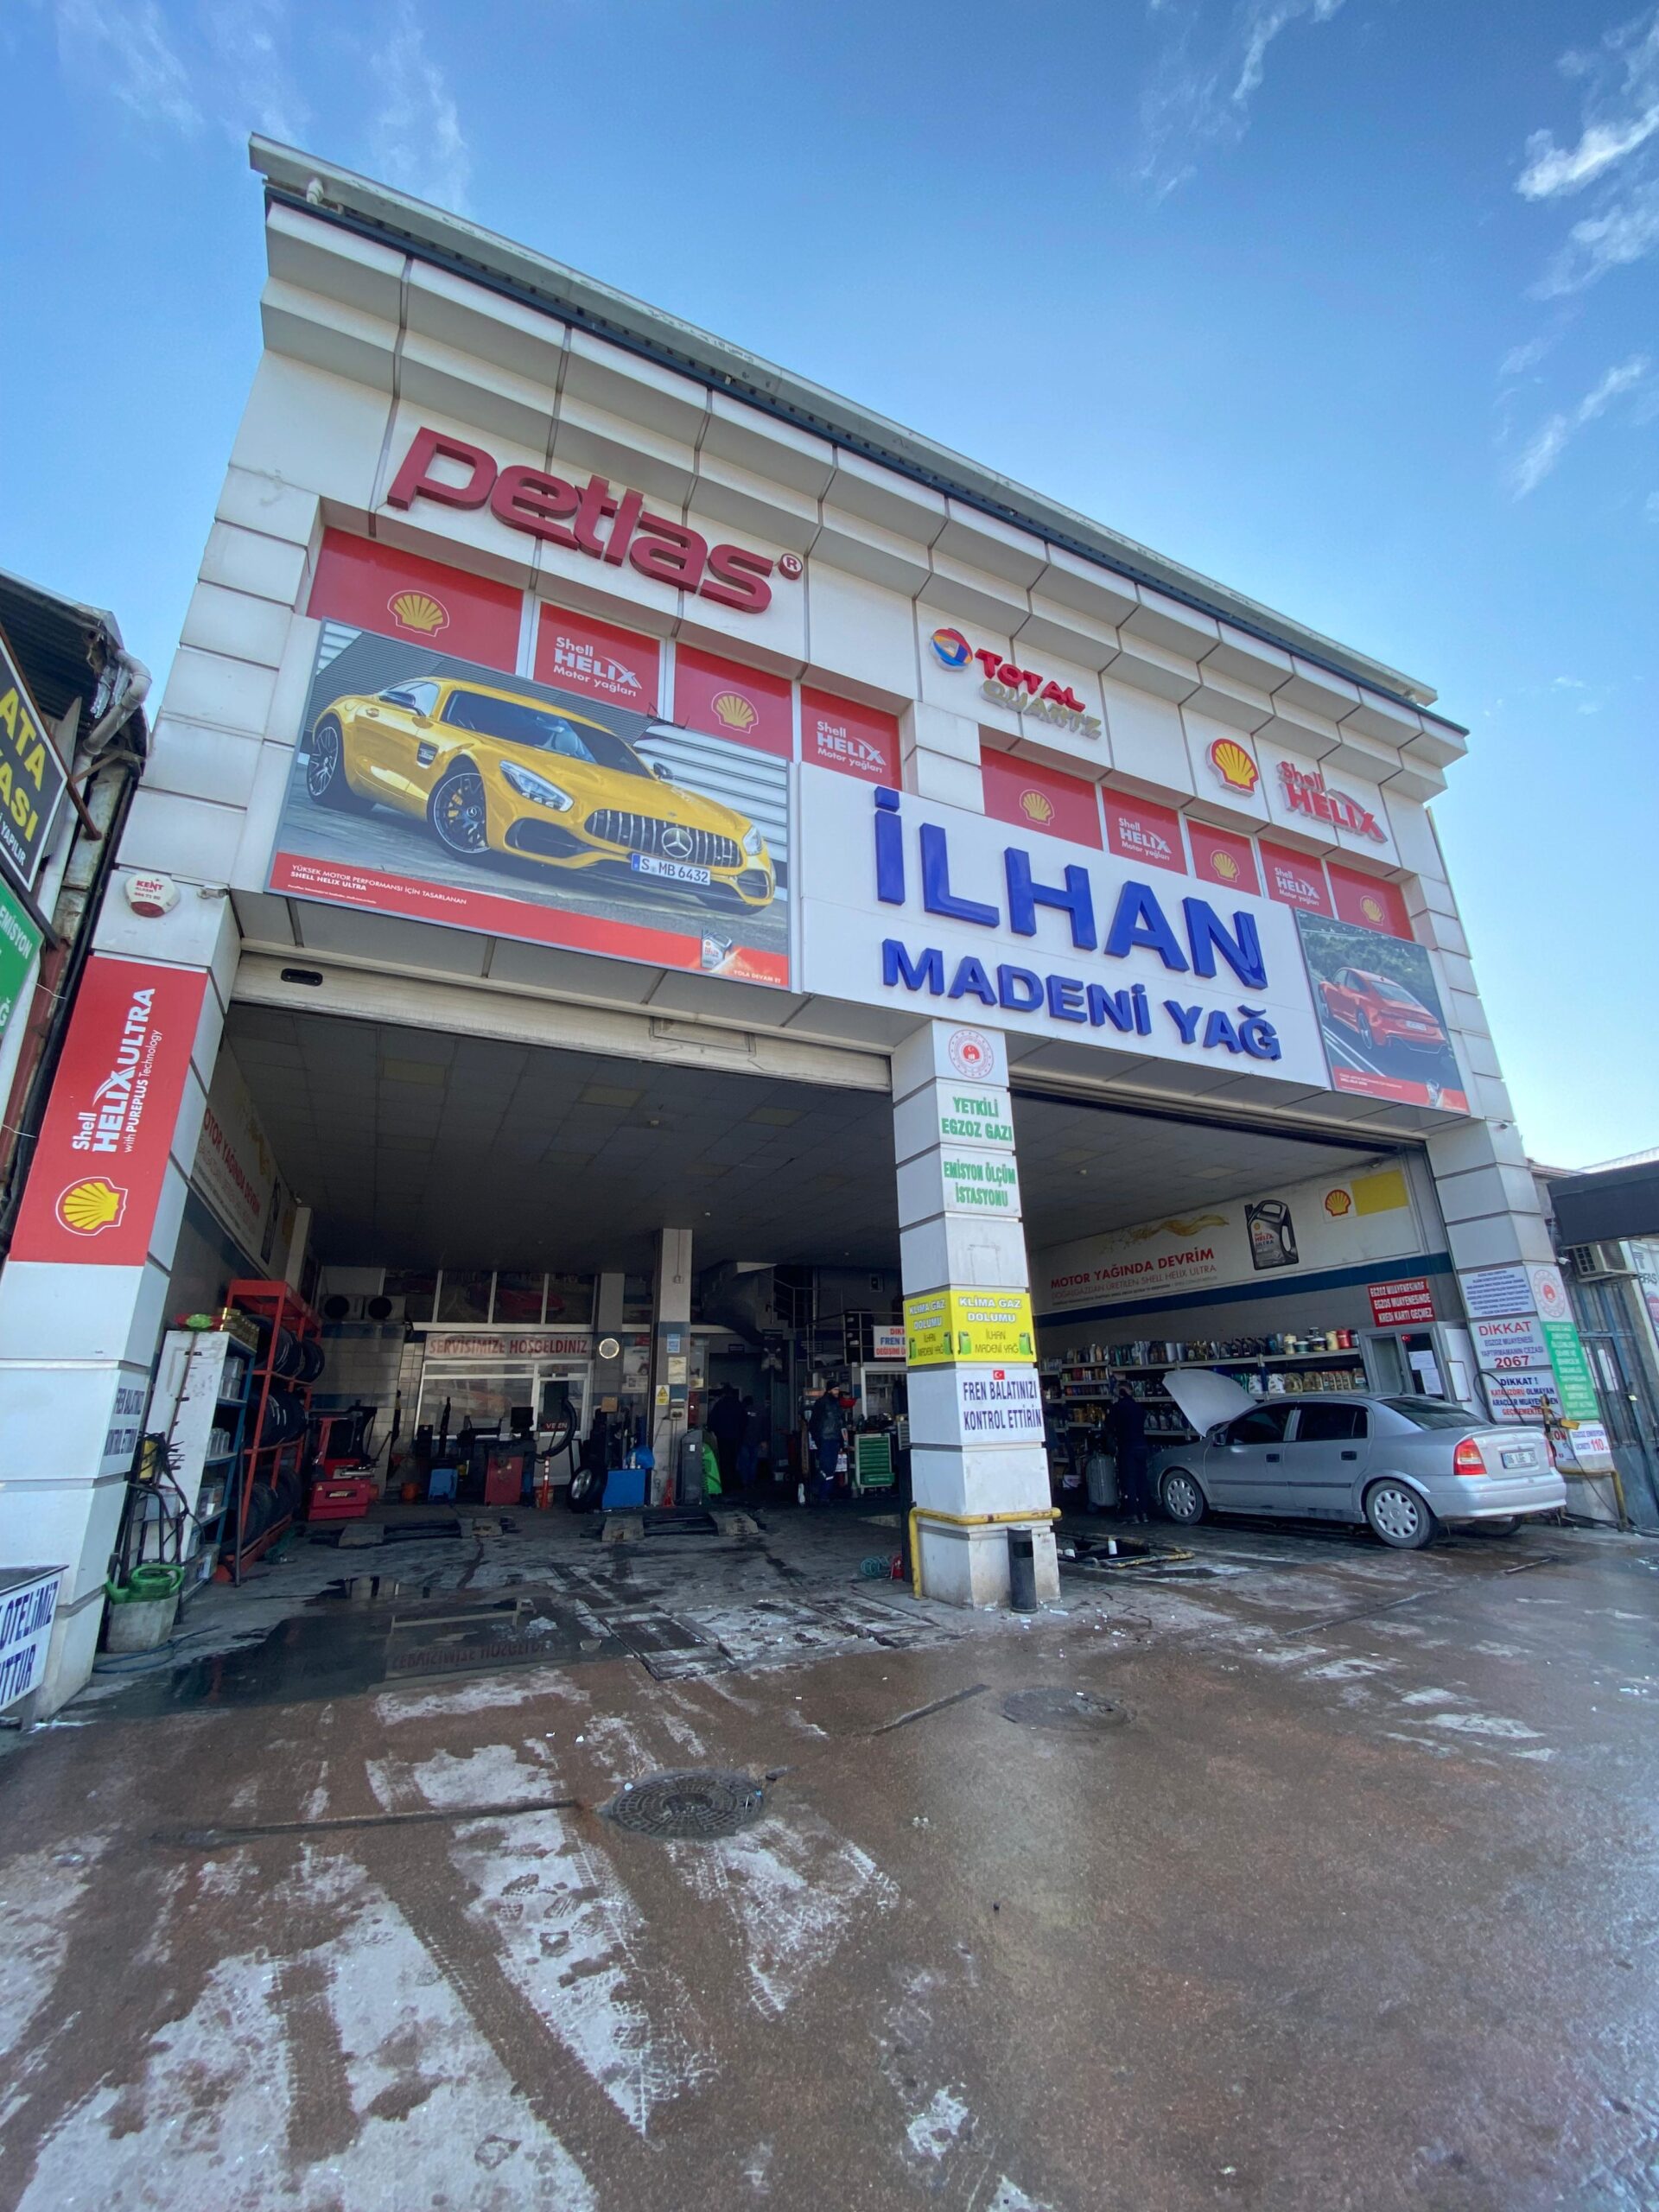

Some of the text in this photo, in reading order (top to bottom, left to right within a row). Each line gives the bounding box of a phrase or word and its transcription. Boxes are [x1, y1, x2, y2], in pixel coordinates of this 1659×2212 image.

[388, 427, 773, 613] petlas
[556, 637, 594, 657] Shell
[553, 665, 637, 697] Motor yağları
[555, 648, 642, 690] HELIX
[975, 648, 1085, 713] TOTAL
[979, 680, 1102, 740] QUARTZ
[817, 721, 847, 738] Shell
[817, 731, 887, 766] HELIX
[817, 747, 847, 762] Motor
[1276, 761, 1325, 792] Shell
[1118, 817, 1141, 831] Shell
[1279, 781, 1389, 843] HELIX
[1, 821, 26, 867] YAPILIR
[1119, 827, 1173, 854] HELIX
[290, 871, 367, 892] SHELL HELIX ULTRA
[291, 864, 467, 905] YÜKSEK MOTOR PERFORMANSI İÇİN TASARLANAN
[658, 861, 676, 875] MB
[678, 866, 709, 884] 6432
[1274, 868, 1294, 880] Shell
[137, 880, 164, 892] KENT
[874, 785, 1268, 991] İLHAN
[1275, 876, 1320, 899] HELIX
[881, 938, 1281, 1061] MADENİ YAĞ
[92, 988, 156, 1152] HELIX ULTRA
[124, 1030, 162, 1153] with PUREPLUS Technology
[953, 1096, 999, 1118] YETKİLİ
[72, 1112, 97, 1150] Shell
[941, 1117, 1013, 1142] EGZOZ GAZI
[944, 1159, 1016, 1187] EMİSYON ÖLÇÜM
[955, 1182, 1009, 1207] İSTASYONU
[1051, 1247, 1215, 1289] MOTOR YAĞINDA DEVRİM
[1141, 1274, 1164, 1286] SHELL
[1189, 1264, 1217, 1276] ULTRA
[958, 1296, 1022, 1309] KLİMA GAZ
[967, 1312, 1016, 1323] DOLUMU
[1478, 1321, 1531, 1336] DİKKAT
[429, 1335, 505, 1354] SERVİSİMİZE
[1494, 1356, 1529, 1369] 2067
[963, 1381, 1038, 1401] FREN BALATINIZI
[1500, 1376, 1531, 1386] DİKKAT
[963, 1404, 1042, 1431] KONTROL ETTİRİN
[1591, 1439, 1604, 1451] 110
